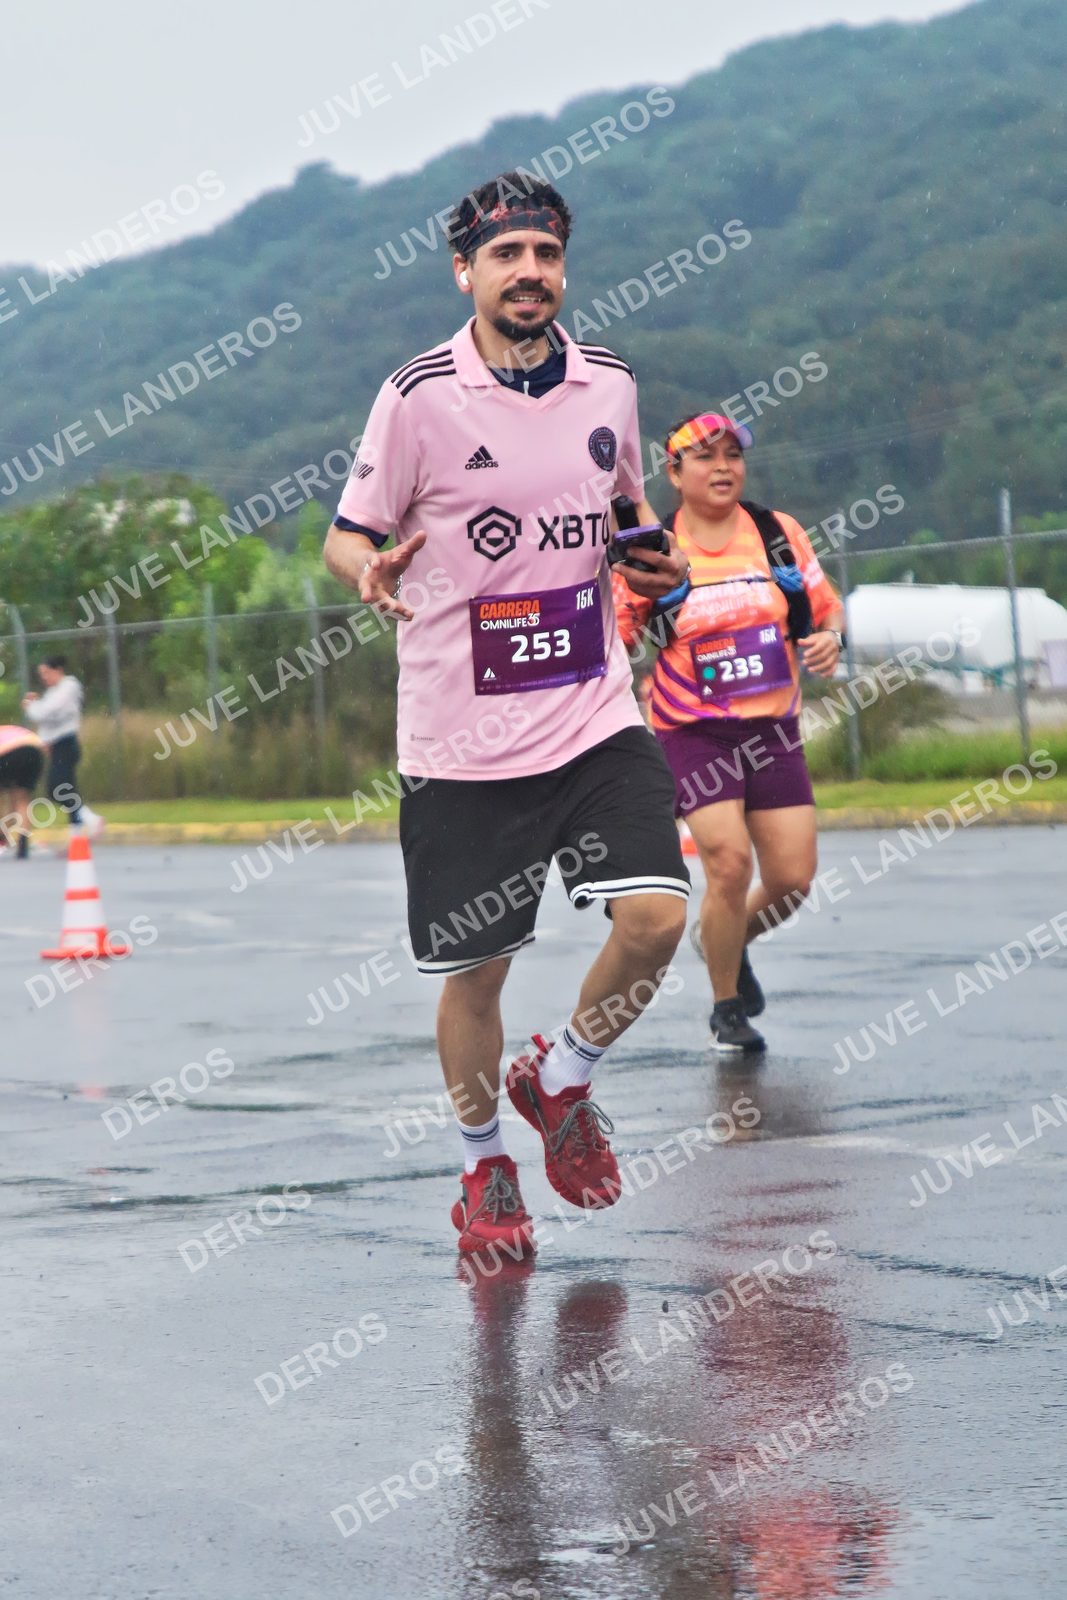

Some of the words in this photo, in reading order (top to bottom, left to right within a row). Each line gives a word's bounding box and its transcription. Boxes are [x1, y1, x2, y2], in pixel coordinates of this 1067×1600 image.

[465, 461, 498, 470] adidas
[480, 600, 540, 619] CARRERA
[576, 587, 594, 611] 15K
[510, 628, 571, 663] 253
[759, 625, 777, 645] 15K
[719, 654, 764, 682] 235
